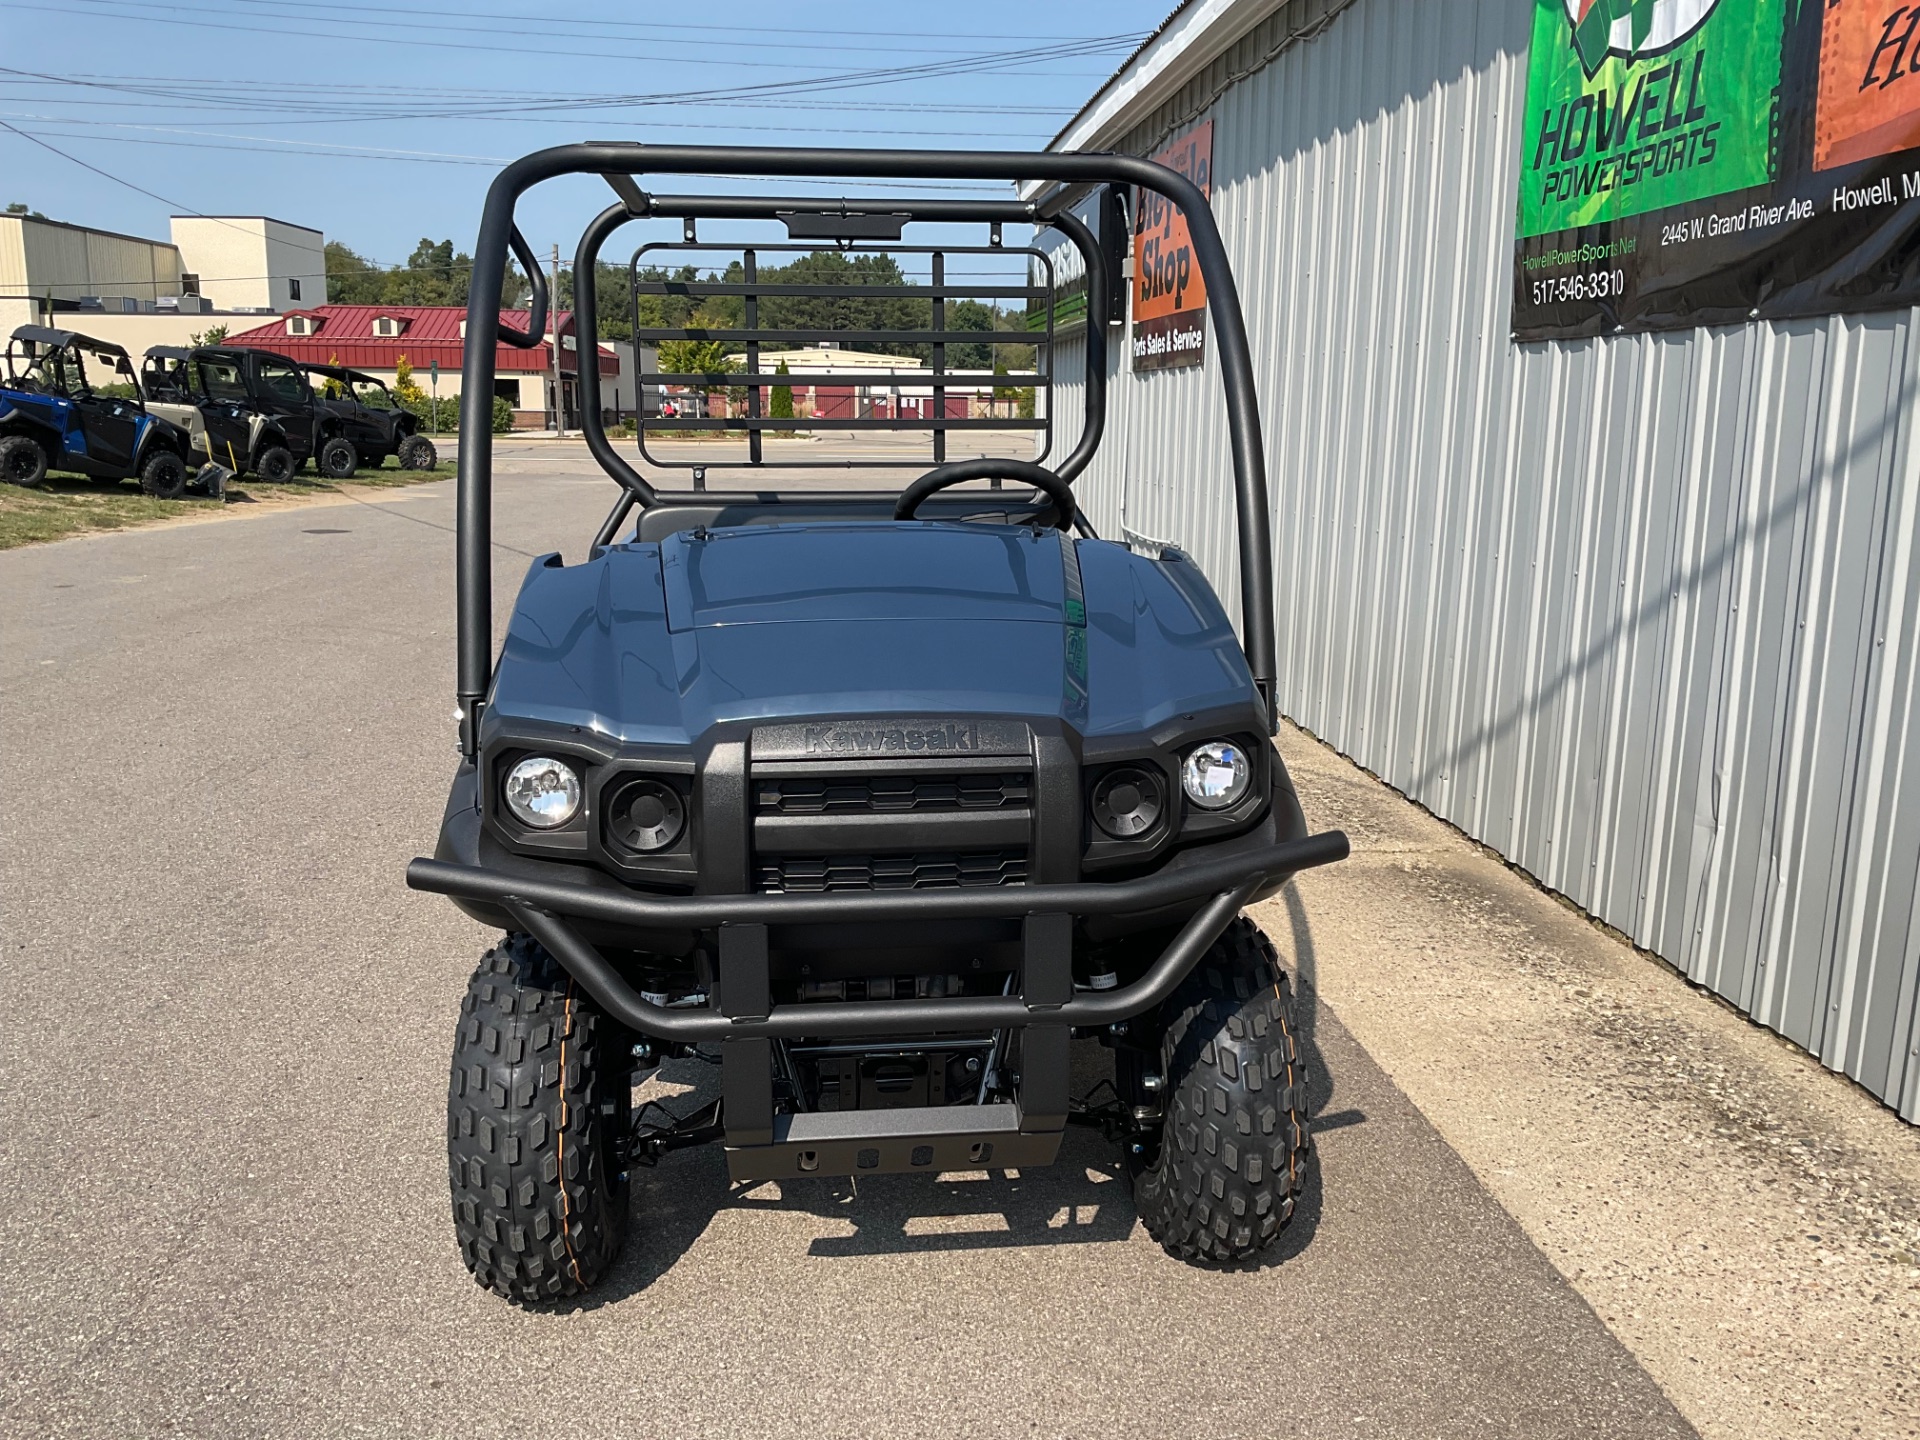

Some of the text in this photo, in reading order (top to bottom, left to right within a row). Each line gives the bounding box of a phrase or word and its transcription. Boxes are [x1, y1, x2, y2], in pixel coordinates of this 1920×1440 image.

[1533, 48, 1706, 170] HOWELL
[1136, 142, 1208, 239] Bicyle
[1542, 121, 1721, 206] POWERSPORTS
[1661, 221, 1689, 246] 2445
[1690, 217, 1705, 239] W.
[1708, 208, 1747, 237] Grand
[1749, 203, 1785, 229] River
[1785, 197, 1815, 221] Ave.
[1833, 176, 1898, 213] Howell,
[1141, 236, 1190, 310] Shop
[1533, 269, 1624, 305] 517-546-3310
[1133, 325, 1203, 357] Parts Sales & Service
[806, 724, 979, 752] Kawasaki
